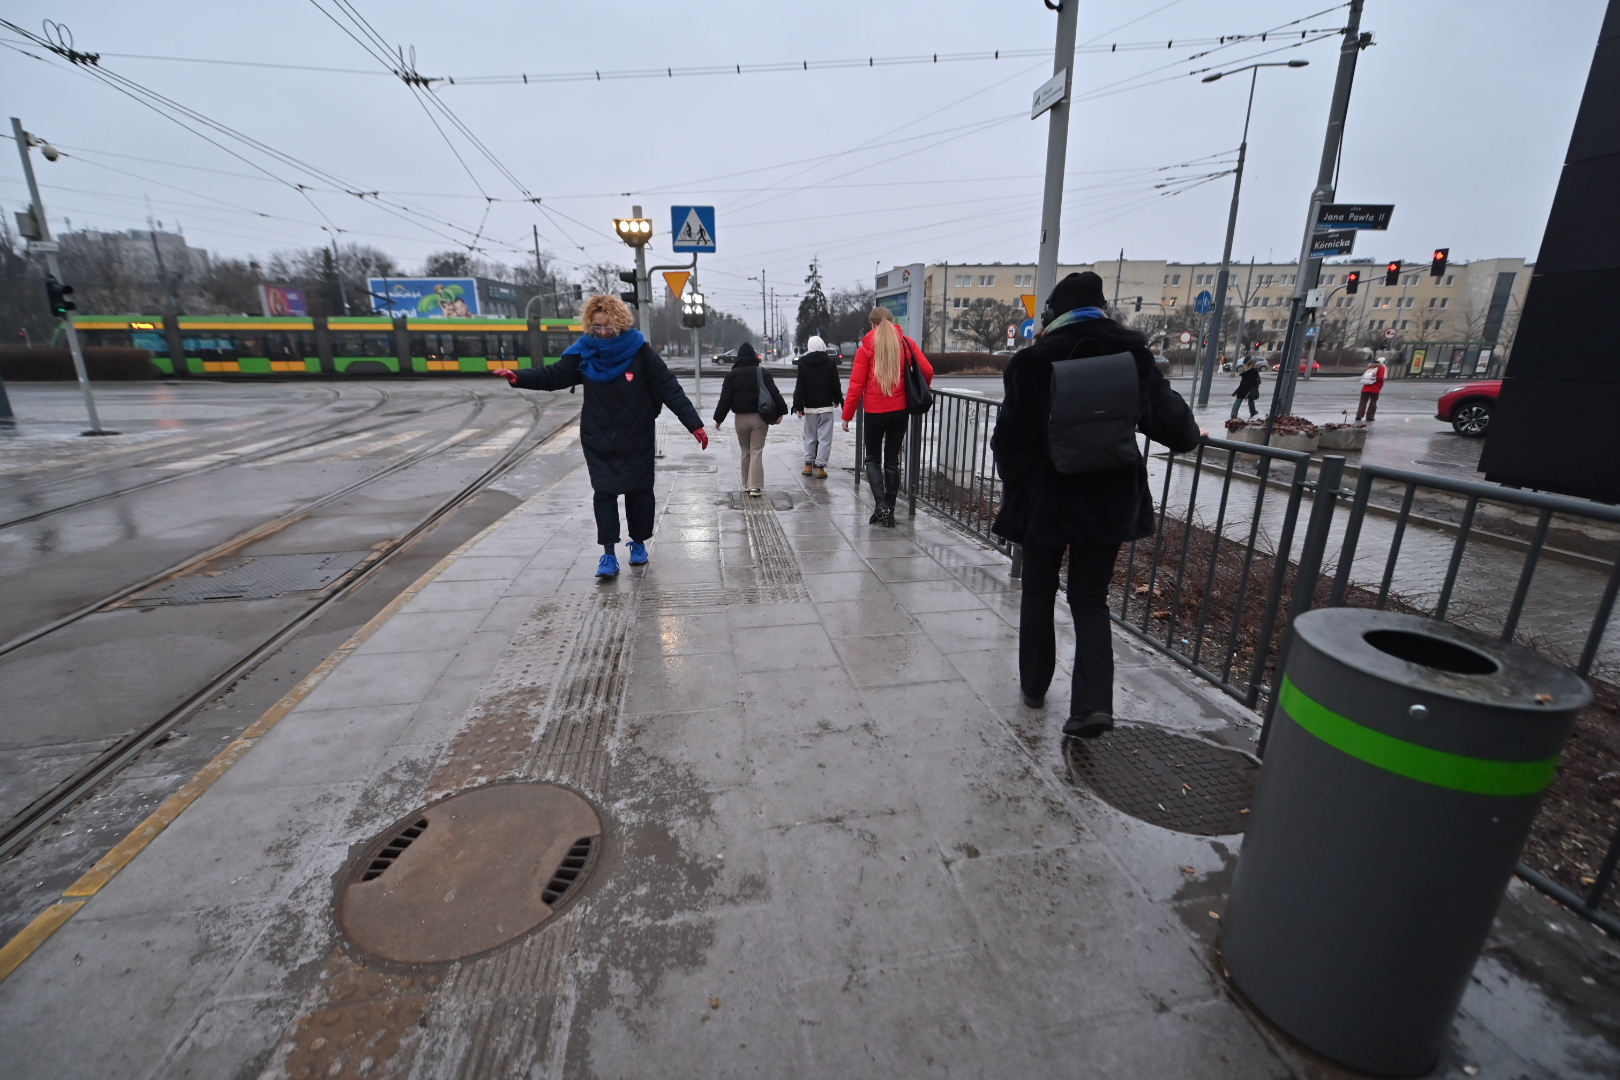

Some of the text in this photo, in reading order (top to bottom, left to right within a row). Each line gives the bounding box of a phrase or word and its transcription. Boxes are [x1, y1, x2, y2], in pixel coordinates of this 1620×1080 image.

[1323, 213, 1385, 221] Jana Pawła II
[1314, 239, 1350, 250] Kórnicka
